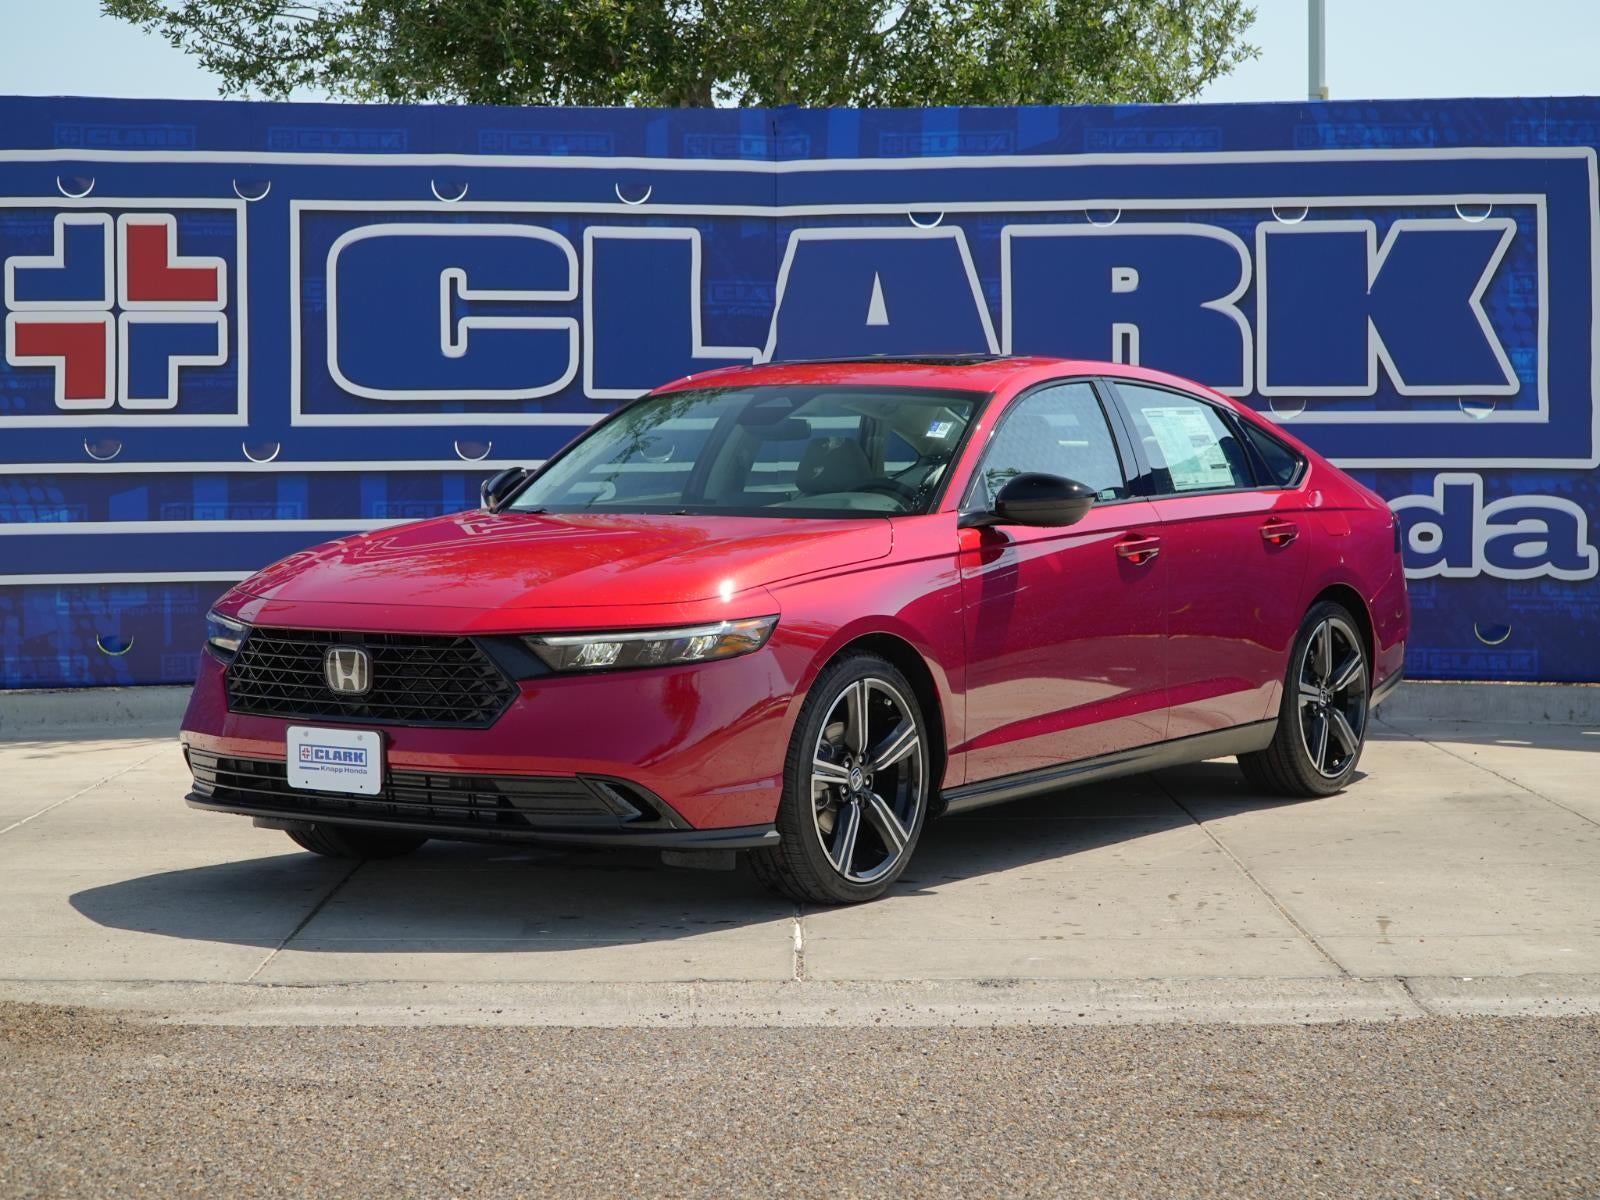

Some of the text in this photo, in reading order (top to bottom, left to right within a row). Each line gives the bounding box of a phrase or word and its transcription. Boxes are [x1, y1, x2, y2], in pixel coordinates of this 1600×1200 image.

[326, 217, 1521, 401] CLARK
[314, 748, 364, 763] CLARK
[320, 765, 368, 775] Knapp Honda
